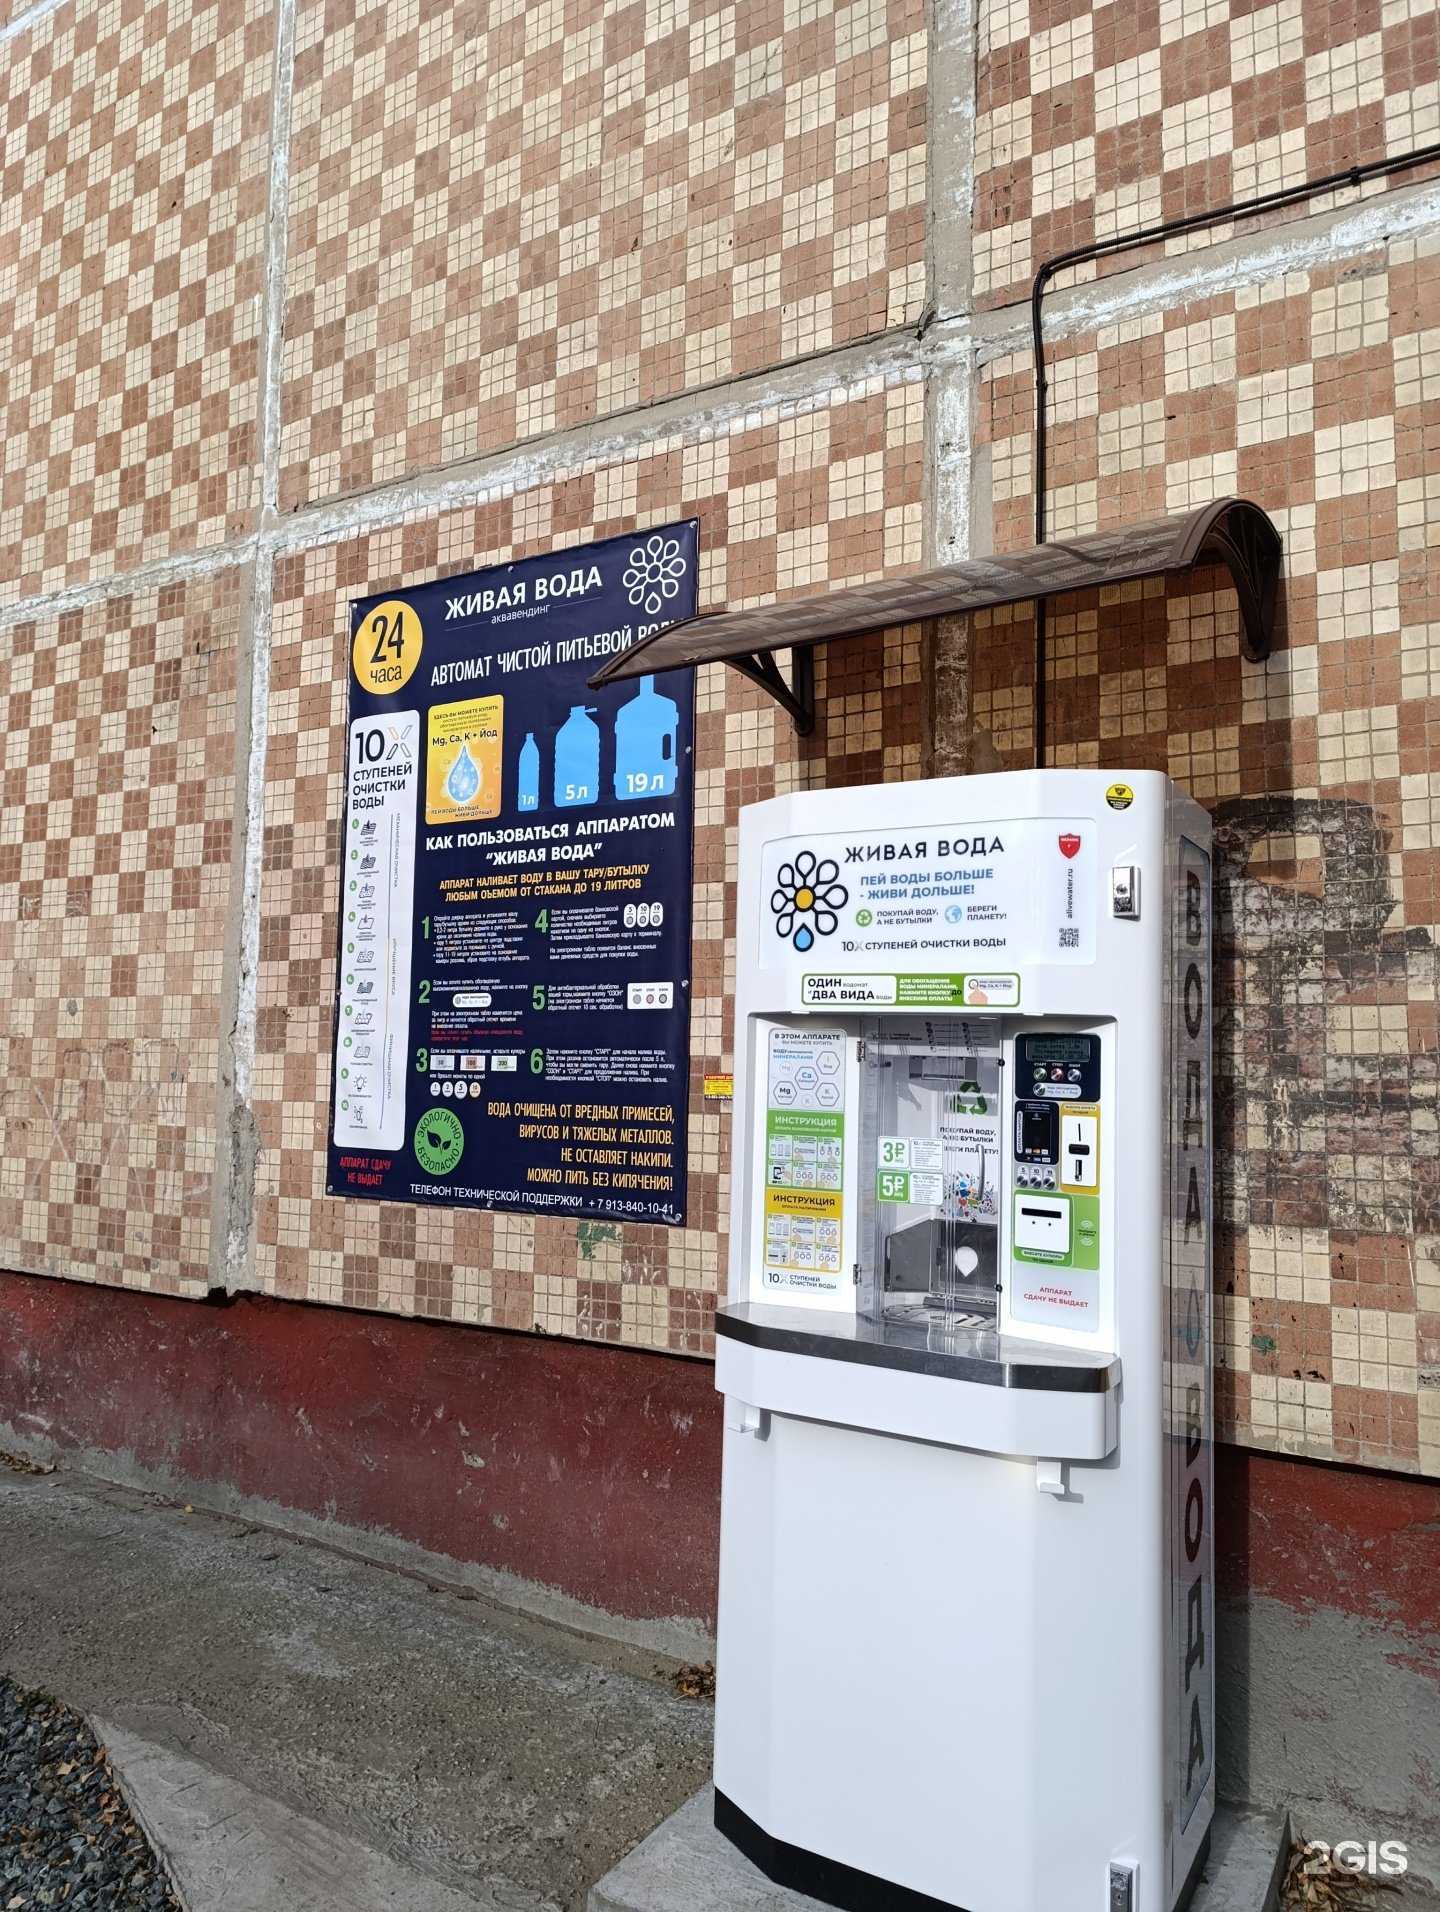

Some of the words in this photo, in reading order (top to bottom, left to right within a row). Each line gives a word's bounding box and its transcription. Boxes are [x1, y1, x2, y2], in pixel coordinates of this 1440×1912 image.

[445, 581, 526, 621] ЖИВАЯ
[535, 566, 602, 600] ВОДА
[491, 604, 551, 624] аквавендинг
[370, 611, 404, 663] 24
[431, 655, 492, 687] АВТОМАТ
[498, 641, 551, 674] ЧИСТОЙ
[556, 625, 632, 663] ПИТЬЕВОЙ
[370, 664, 402, 683] часа
[432, 736, 448, 747] Mg,
[450, 734, 462, 744] Ca,
[480, 729, 498, 738] Йод
[353, 762, 412, 782] СТУПЕНЕЙ
[353, 780, 406, 796] ОЧИСТКИ
[352, 796, 385, 810] ВОДЫ
[426, 836, 454, 850] КАК
[458, 824, 569, 848] ПОЛЬЗОВАТЬСЯ
[576, 812, 675, 836] АППАРАТОМ
[844, 841, 928, 864] ЖИВАЯ
[937, 836, 1005, 858] ВОДА
[439, 878, 474, 890] АППАРАТ
[476, 874, 518, 887] НАЛИВАЕТ
[520, 872, 544, 884] ВОДУ
[546, 872, 552, 882] В
[555, 869, 581, 882] ВАШУ
[584, 864, 650, 880] ТАРУ/БУТЫЛКУ
[860, 873, 886, 886] ПЕЙ
[890, 872, 931, 886] ВОДЫ
[934, 868, 994, 882] БОЛЬШЕ
[445, 889, 478, 902] ЛЮБЫМ
[480, 886, 518, 900] ОЪЕМОМ
[520, 886, 531, 896] ОТ
[534, 883, 572, 896] СТАКАНА
[574, 882, 588, 894] ДО
[590, 881, 602, 892] 19
[604, 878, 642, 890] ЛИТРОВ
[868, 887, 908, 900] ЖИВИ
[911, 884, 975, 900] ДОЛЬШЕ!
[876, 908, 912, 918] ПОКУПАЙ
[914, 907, 939, 918] ВОДУ,
[967, 904, 998, 913] БЕРЕГИ
[967, 912, 1007, 922] ПЛАНЕТУ!
[422, 915, 430, 940] 1
[534, 909, 548, 934] 4
[896, 916, 932, 925] БУТЫЛКИ
[865, 938, 918, 950] СТУПЕНЕЙ
[920, 938, 970, 950] ОЧИСТКИ
[973, 937, 1007, 949] ВОДЫ
[418, 980, 430, 1004] 2
[808, 978, 842, 988] ОДИН
[532, 984, 545, 1010] 5
[812, 990, 840, 1000] ДВА
[841, 990, 875, 1000] ВИДА
[416, 1048, 428, 1072] 3
[530, 1048, 544, 1074] 6
[488, 1102, 511, 1118] ВОДА
[514, 1102, 556, 1119] ОЧИЩЕНА
[560, 1104, 572, 1118] ОТ
[575, 1104, 618, 1122] ВРЕДНЫХ
[622, 1104, 675, 1124] ПРИМЕСЕЙ,
[775, 1116, 837, 1127] ИНСТРУКЦИЯ
[417, 1112, 461, 1140] ЭКОЛОГИЧНО
[519, 1124, 559, 1139] ВИРУСОВ
[562, 1126, 570, 1140] И
[572, 1126, 616, 1142] ТЯЖЕЛЫХ
[620, 1128, 674, 1145] МЕТАЛЛОВ.
[418, 1146, 460, 1172] БЕЗОПАСНО
[561, 1148, 572, 1162] НЕ
[576, 1148, 628, 1166] ОСТАВЛЯЕТ
[630, 1152, 674, 1168] НАКИПИ.
[964, 1147, 999, 1155] ПЛАЕТУ!
[339, 1156, 368, 1168] АППАРАТ
[371, 1158, 392, 1171] СДАЧУ
[348, 1172, 356, 1184] НЕ
[358, 1173, 382, 1186] ВЫДАЕТ
[527, 1168, 562, 1184] МОЖНО
[565, 1169, 588, 1185] ПИТЬ
[592, 1172, 608, 1186] БЕЗ
[612, 1172, 674, 1192] КИПЯЧЕНИЯ!
[410, 1184, 452, 1197] ТЕЛЕФОН
[454, 1186, 520, 1202] ТЕХНИЧЕСКОЙ
[522, 1193, 583, 1208] ПОДДЕРЖКИ
[597, 1199, 604, 1209] 7
[604, 1199, 674, 1215] 913-840-10-41
[773, 1194, 836, 1206] ИНСТРУКЦИЯ
[1024, 1293, 1047, 1303] СДАЧУ
[1058, 1298, 1088, 1308] ВЫДАЕТ
[1040, 1286, 1072, 1296] АППАРАТ
